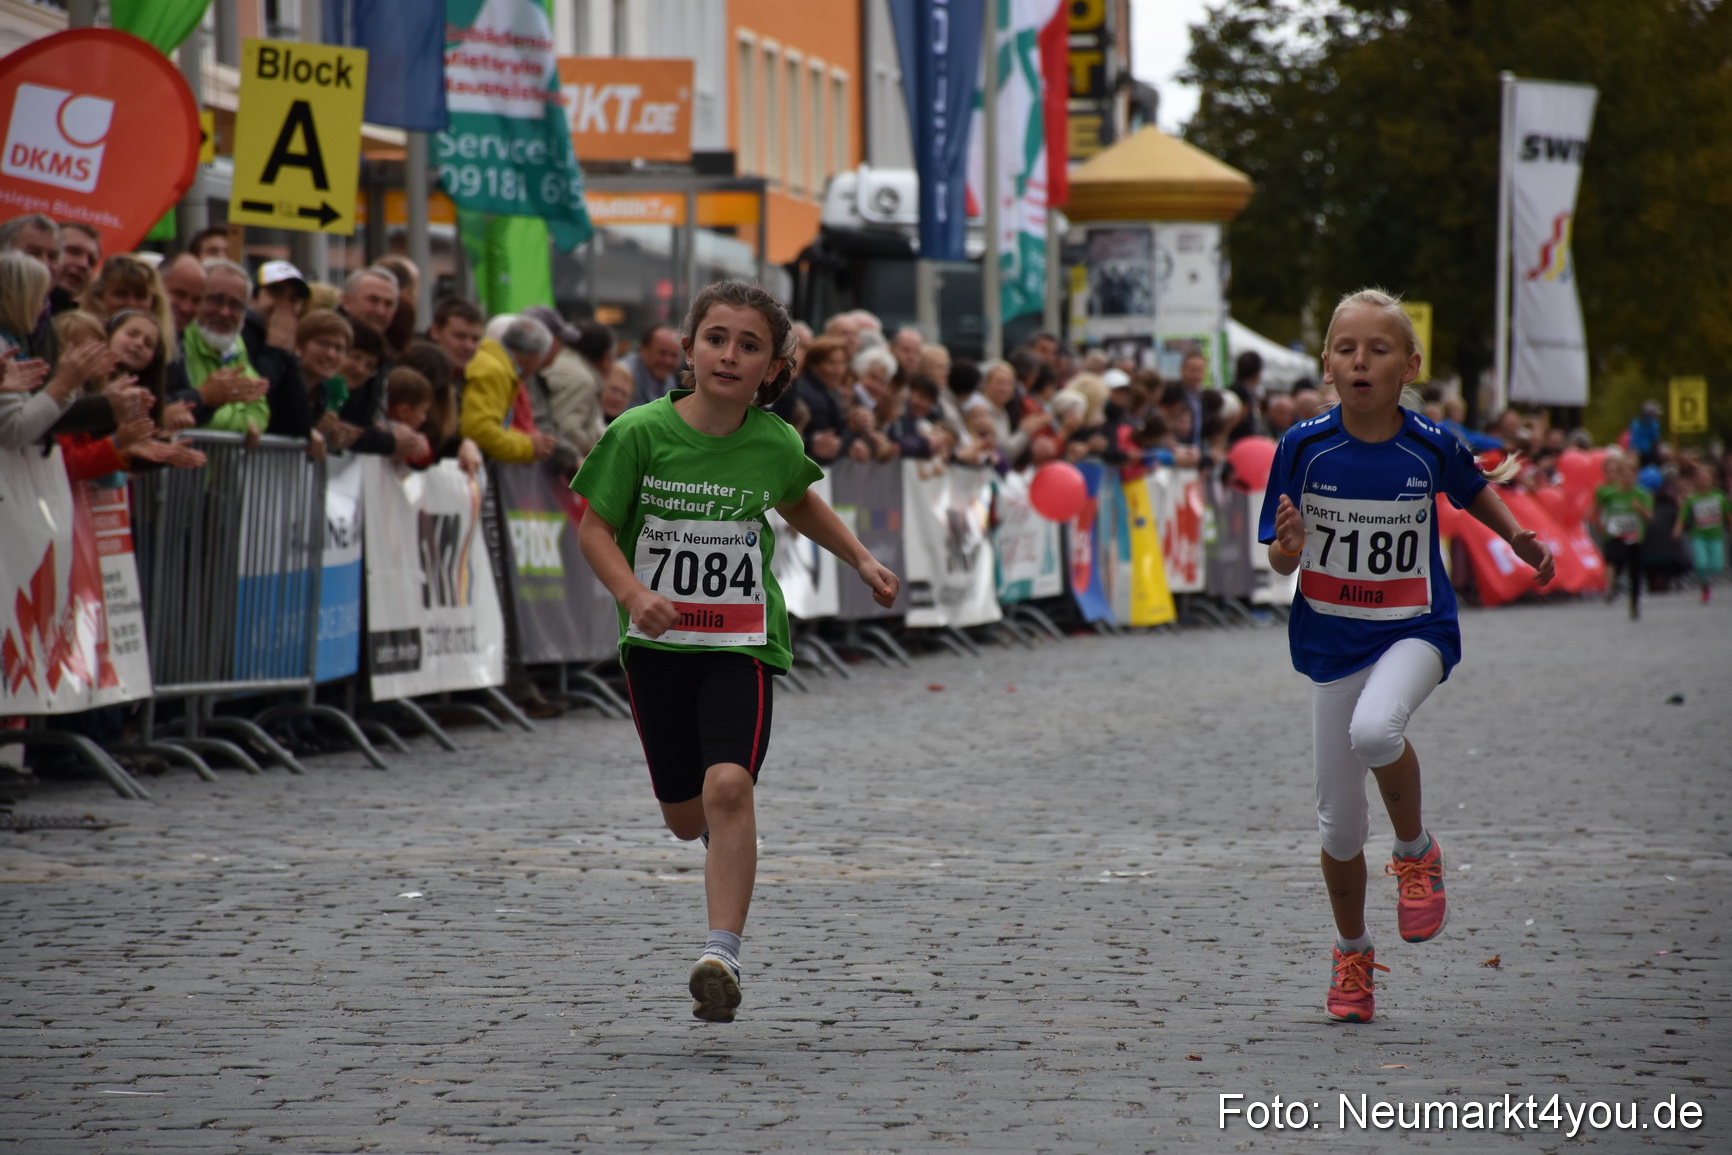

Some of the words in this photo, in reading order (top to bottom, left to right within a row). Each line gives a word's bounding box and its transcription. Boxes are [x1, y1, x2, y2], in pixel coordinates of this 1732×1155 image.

[257, 47, 352, 89] Block
[259, 100, 330, 191] A
[9, 143, 93, 181] DKMS
[642, 475, 736, 498] Neumarkter
[1320, 484, 1337, 492] JAKO
[1406, 476, 1428, 488] Alina
[641, 492, 715, 516] Stadtlauf
[1306, 504, 1345, 523] PARTL
[1348, 512, 1412, 525] Neumarkt
[641, 526, 680, 543] PARTL
[1315, 524, 1419, 575] 7180
[648, 547, 756, 598] 7084
[1416, 569, 1423, 577] K
[754, 593, 761, 602] K
[1338, 584, 1384, 604] Alina
[677, 609, 724, 628] milia
